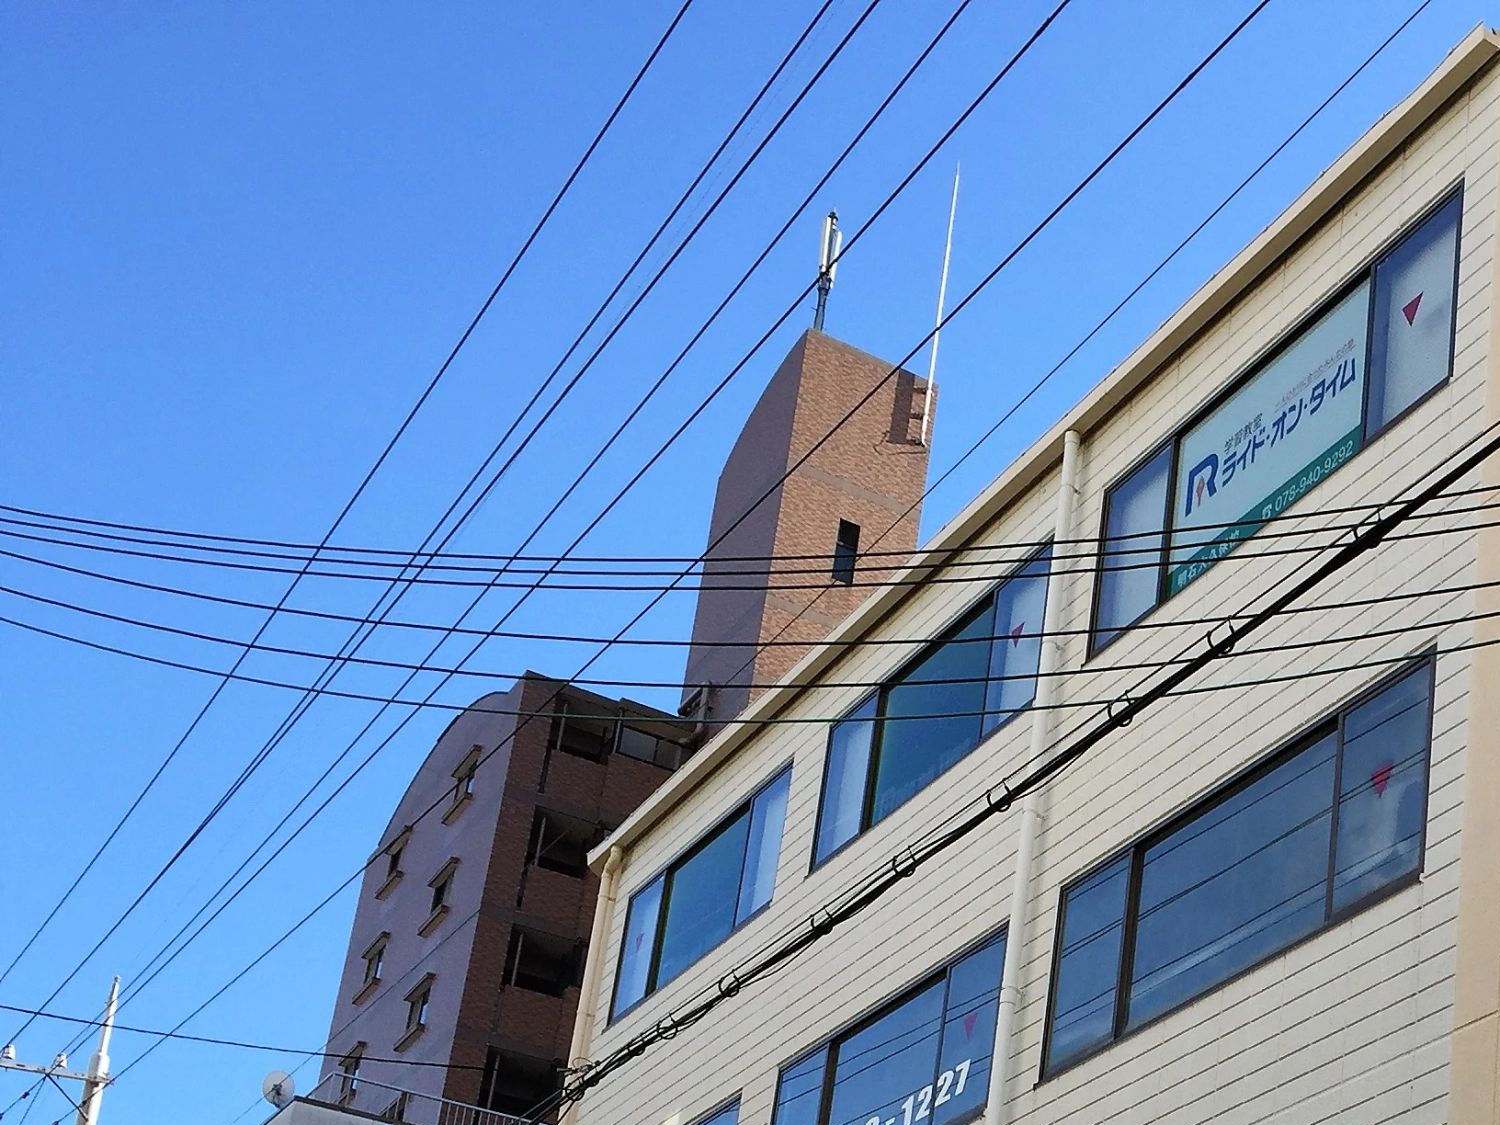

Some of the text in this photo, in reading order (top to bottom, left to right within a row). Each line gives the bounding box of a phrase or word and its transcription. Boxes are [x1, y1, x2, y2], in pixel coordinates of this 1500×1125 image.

[1224, 411, 1263, 455] 学習教室
[1274, 439, 1354, 511] 078-940-9292
